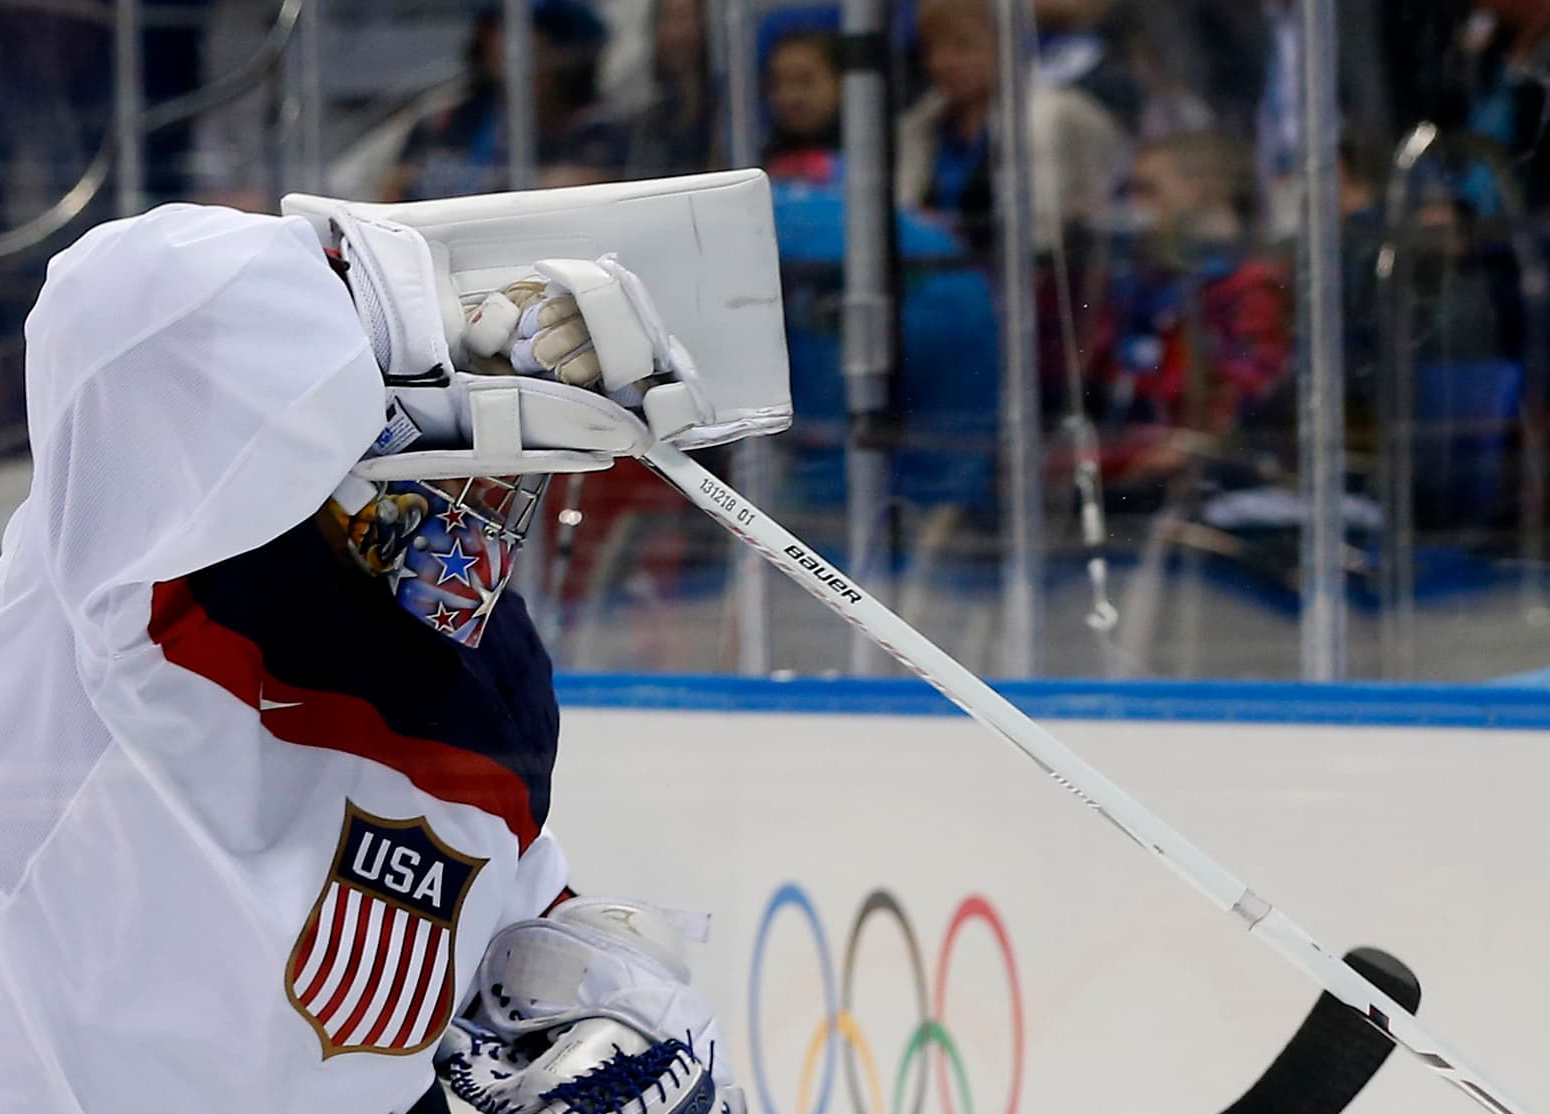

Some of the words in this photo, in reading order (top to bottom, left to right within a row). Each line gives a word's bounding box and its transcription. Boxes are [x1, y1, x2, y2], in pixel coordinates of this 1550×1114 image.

[700, 478, 737, 512] 131218
[737, 508, 756, 526] 01
[783, 544, 863, 604] BAUER
[352, 831, 445, 908] USA
